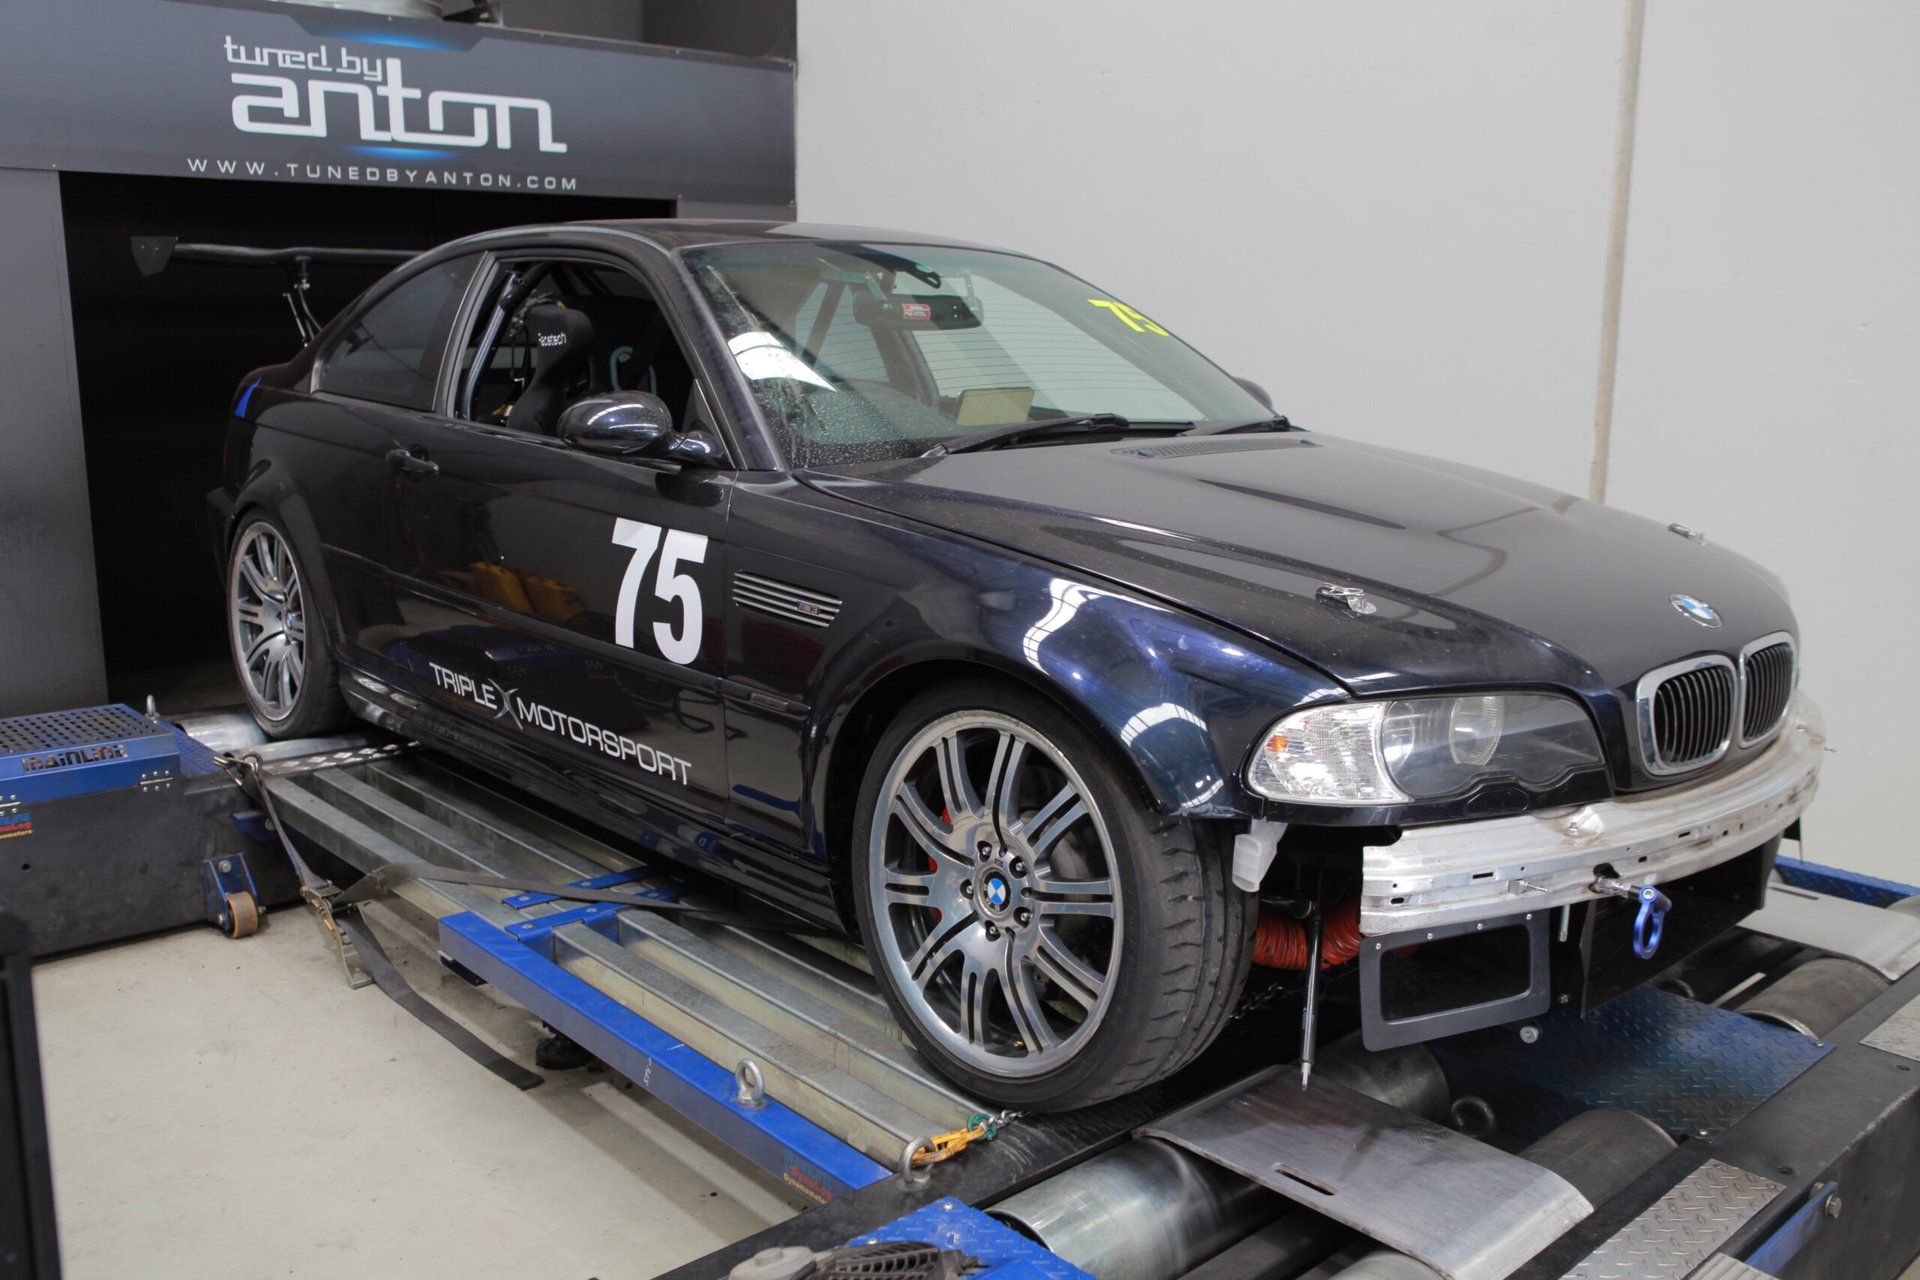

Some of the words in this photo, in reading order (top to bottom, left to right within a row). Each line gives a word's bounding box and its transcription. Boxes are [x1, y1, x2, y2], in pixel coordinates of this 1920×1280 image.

[224, 36, 332, 72] tuned
[336, 47, 382, 81] by
[231, 58, 567, 152] anton
[187, 158, 577, 190] WWW.TUNEDBYANTON.COM
[1088, 299, 1169, 337] 75
[612, 517, 709, 665] 75
[516, 696, 692, 785] MOTORSPORT
